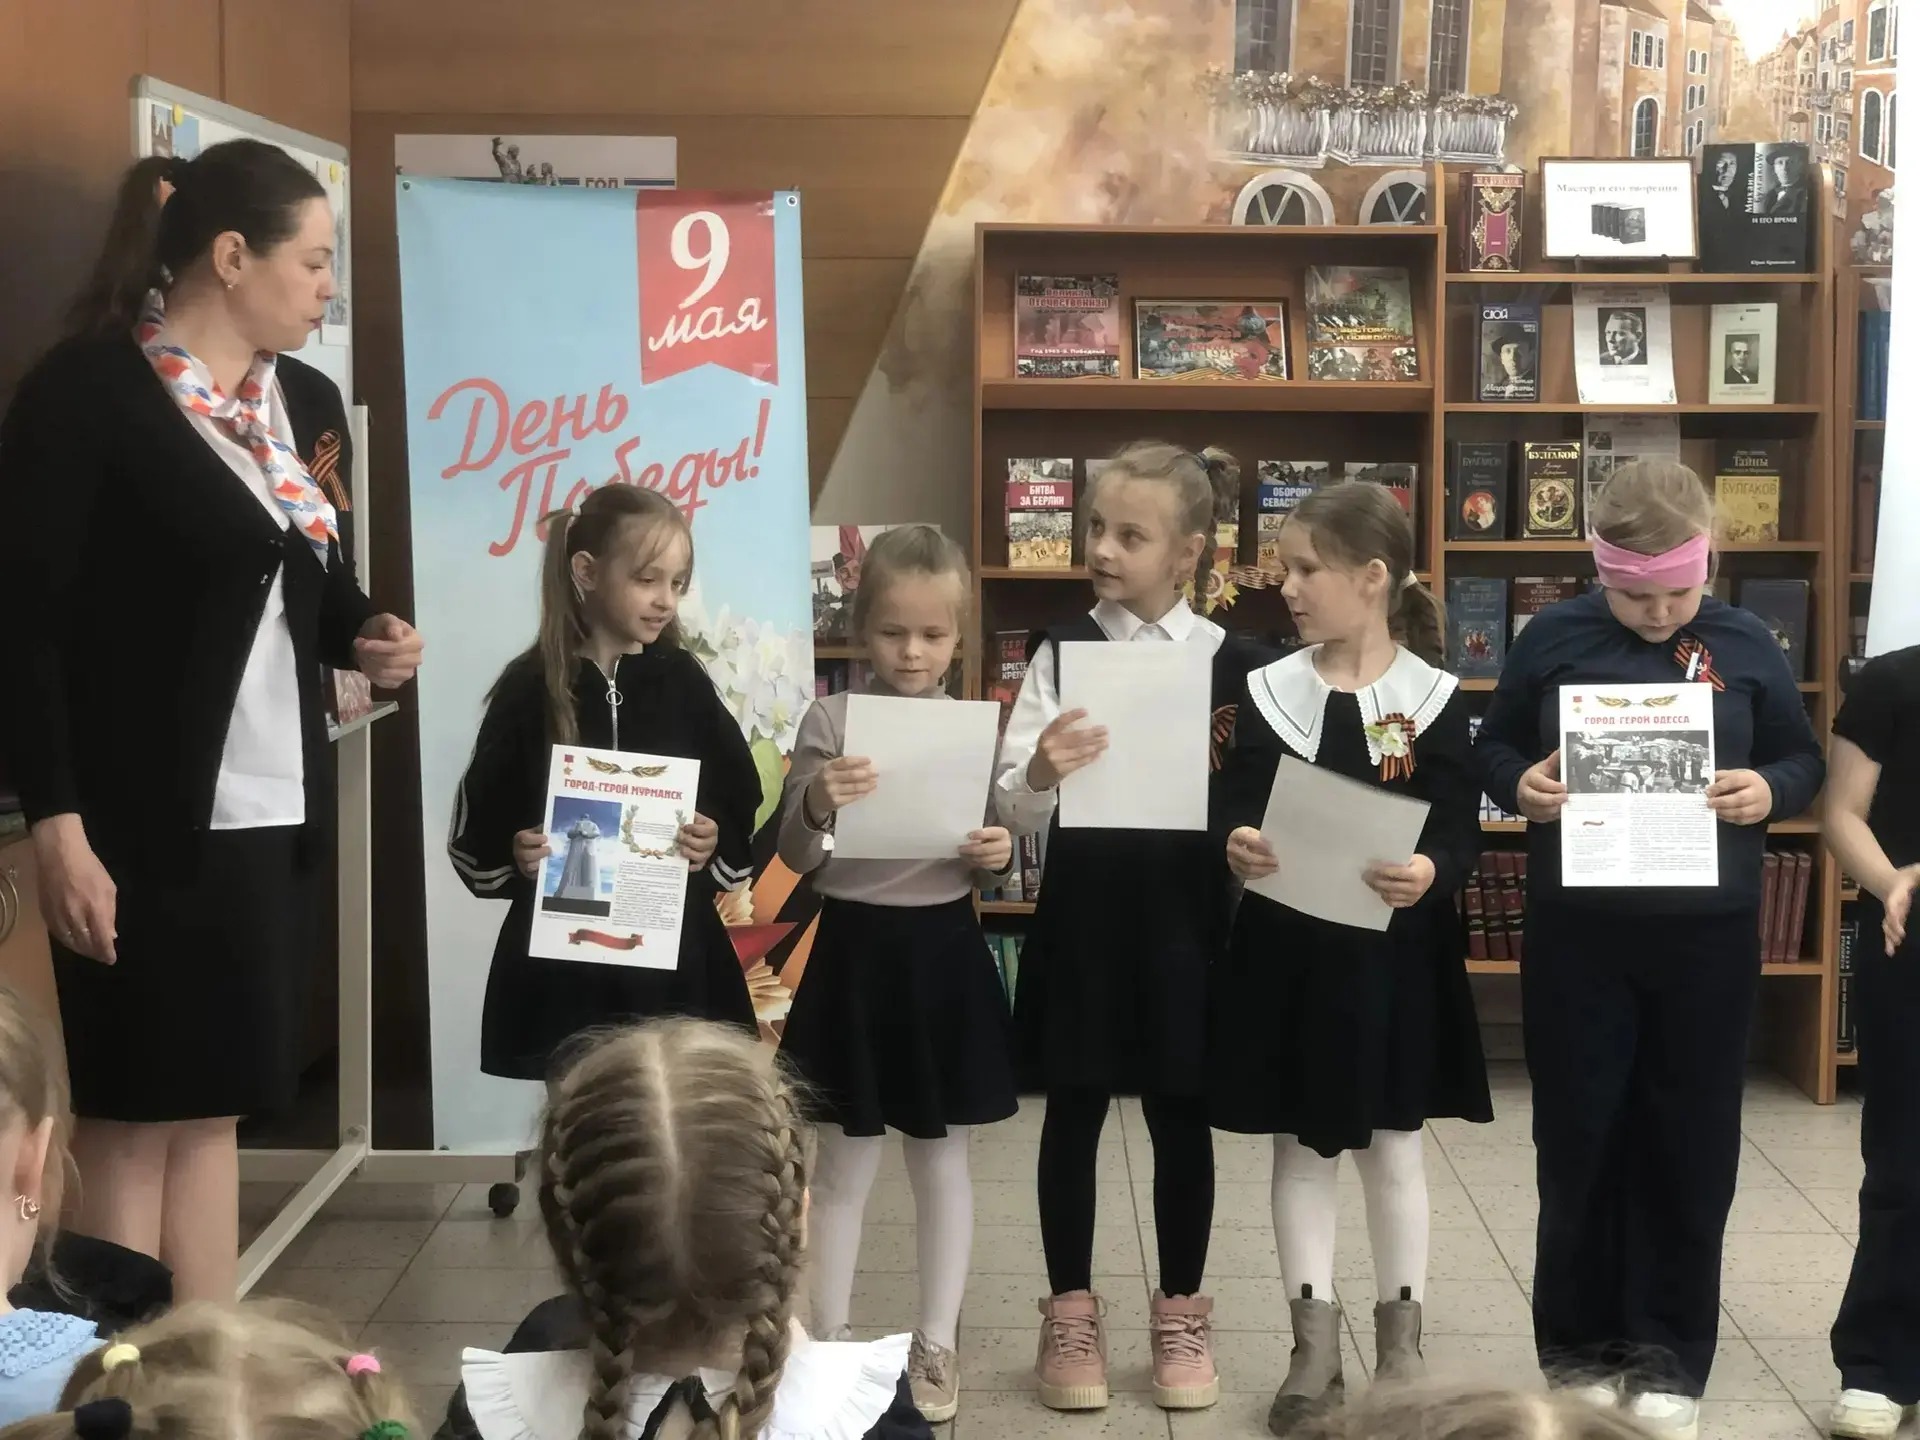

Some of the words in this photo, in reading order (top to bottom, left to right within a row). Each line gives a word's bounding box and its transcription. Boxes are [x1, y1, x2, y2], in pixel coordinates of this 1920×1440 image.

[671, 211, 730, 308] 9
[648, 297, 768, 352] мая
[427, 378, 630, 480] День
[1528, 451, 1578, 460] БУЛГАКОВ
[1732, 456, 1769, 467] Тайны
[1029, 485, 1056, 495] БИТВА
[1722, 482, 1778, 495] БУЛГАКОВ
[1019, 496, 1031, 506] ЗА
[1032, 496, 1065, 505] БЕРЛИН
[1035, 547, 1048, 559] 16
[1001, 671, 1027, 680] КРЕПО
[1653, 715, 1690, 725] ОДЕССА
[631, 786, 683, 800] МУРМАНСК
